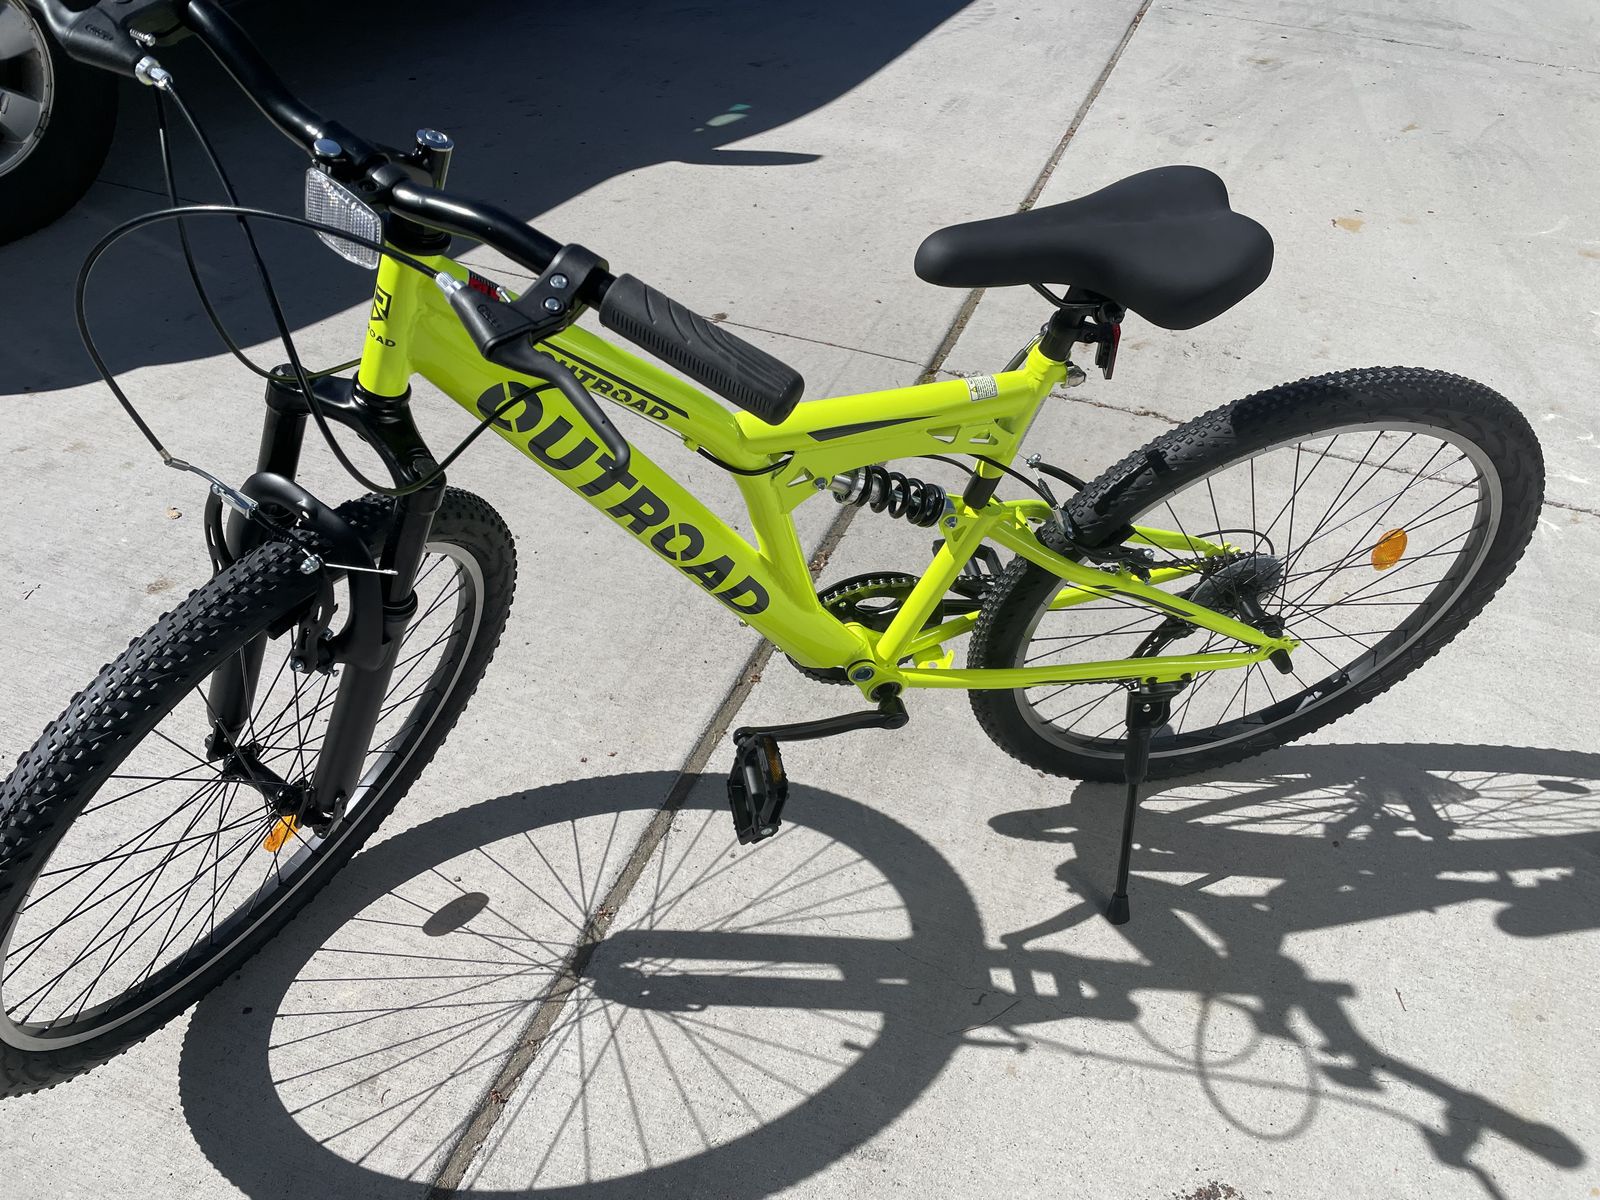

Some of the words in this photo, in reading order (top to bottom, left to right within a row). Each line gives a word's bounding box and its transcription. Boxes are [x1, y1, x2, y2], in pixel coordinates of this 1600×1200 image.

[367, 323, 396, 347] OAD
[540, 350, 669, 420] TROAD
[477, 381, 770, 614] OUTROAD
